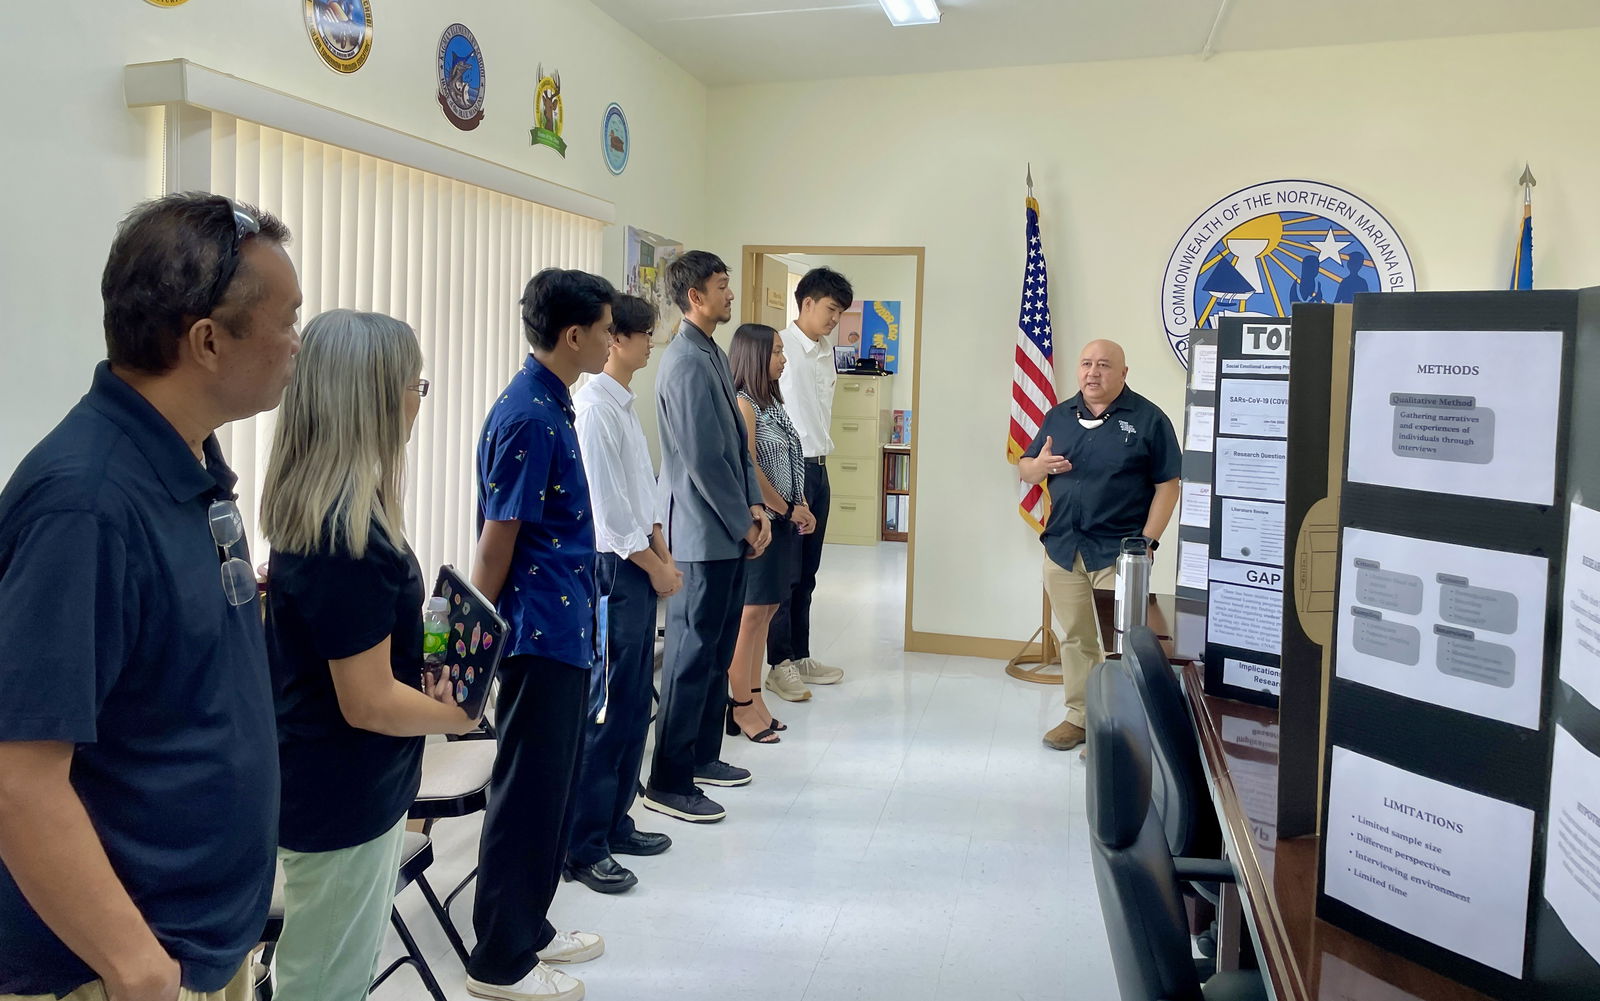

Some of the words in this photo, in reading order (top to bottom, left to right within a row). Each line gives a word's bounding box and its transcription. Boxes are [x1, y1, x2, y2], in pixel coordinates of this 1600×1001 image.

[1172, 216, 1224, 325] COMMONWEALTH
[1223, 204, 1241, 221] OF
[1243, 192, 1272, 210] THE
[1277, 190, 1358, 220] NORTHERN
[1355, 214, 1400, 272] MARIANA
[1417, 364, 1480, 376] METHODS
[1393, 396, 1436, 406] Qualitative
[1439, 398, 1472, 408] Method
[1400, 411, 1437, 422] Gathering
[1438, 414, 1480, 423] narratives
[1415, 424, 1460, 434] experiences
[1398, 433, 1440, 443] individuals
[1442, 436, 1474, 446] through
[1398, 444, 1437, 453] interviews
[1246, 570, 1280, 585] GAP
[1239, 662, 1280, 677] Implication
[1254, 676, 1280, 687] Resear
[1383, 797, 1464, 834] LIMITATIONS
[1358, 815, 1390, 834] Limited
[1391, 830, 1422, 847] sample
[1425, 840, 1442, 854] size
[1356, 832, 1393, 854] Different
[1395, 848, 1451, 876] perspectives
[1354, 868, 1386, 889] Limited
[1388, 883, 1408, 898] time
[1355, 850, 1408, 881] Interviewing
[1411, 876, 1471, 903] environment
